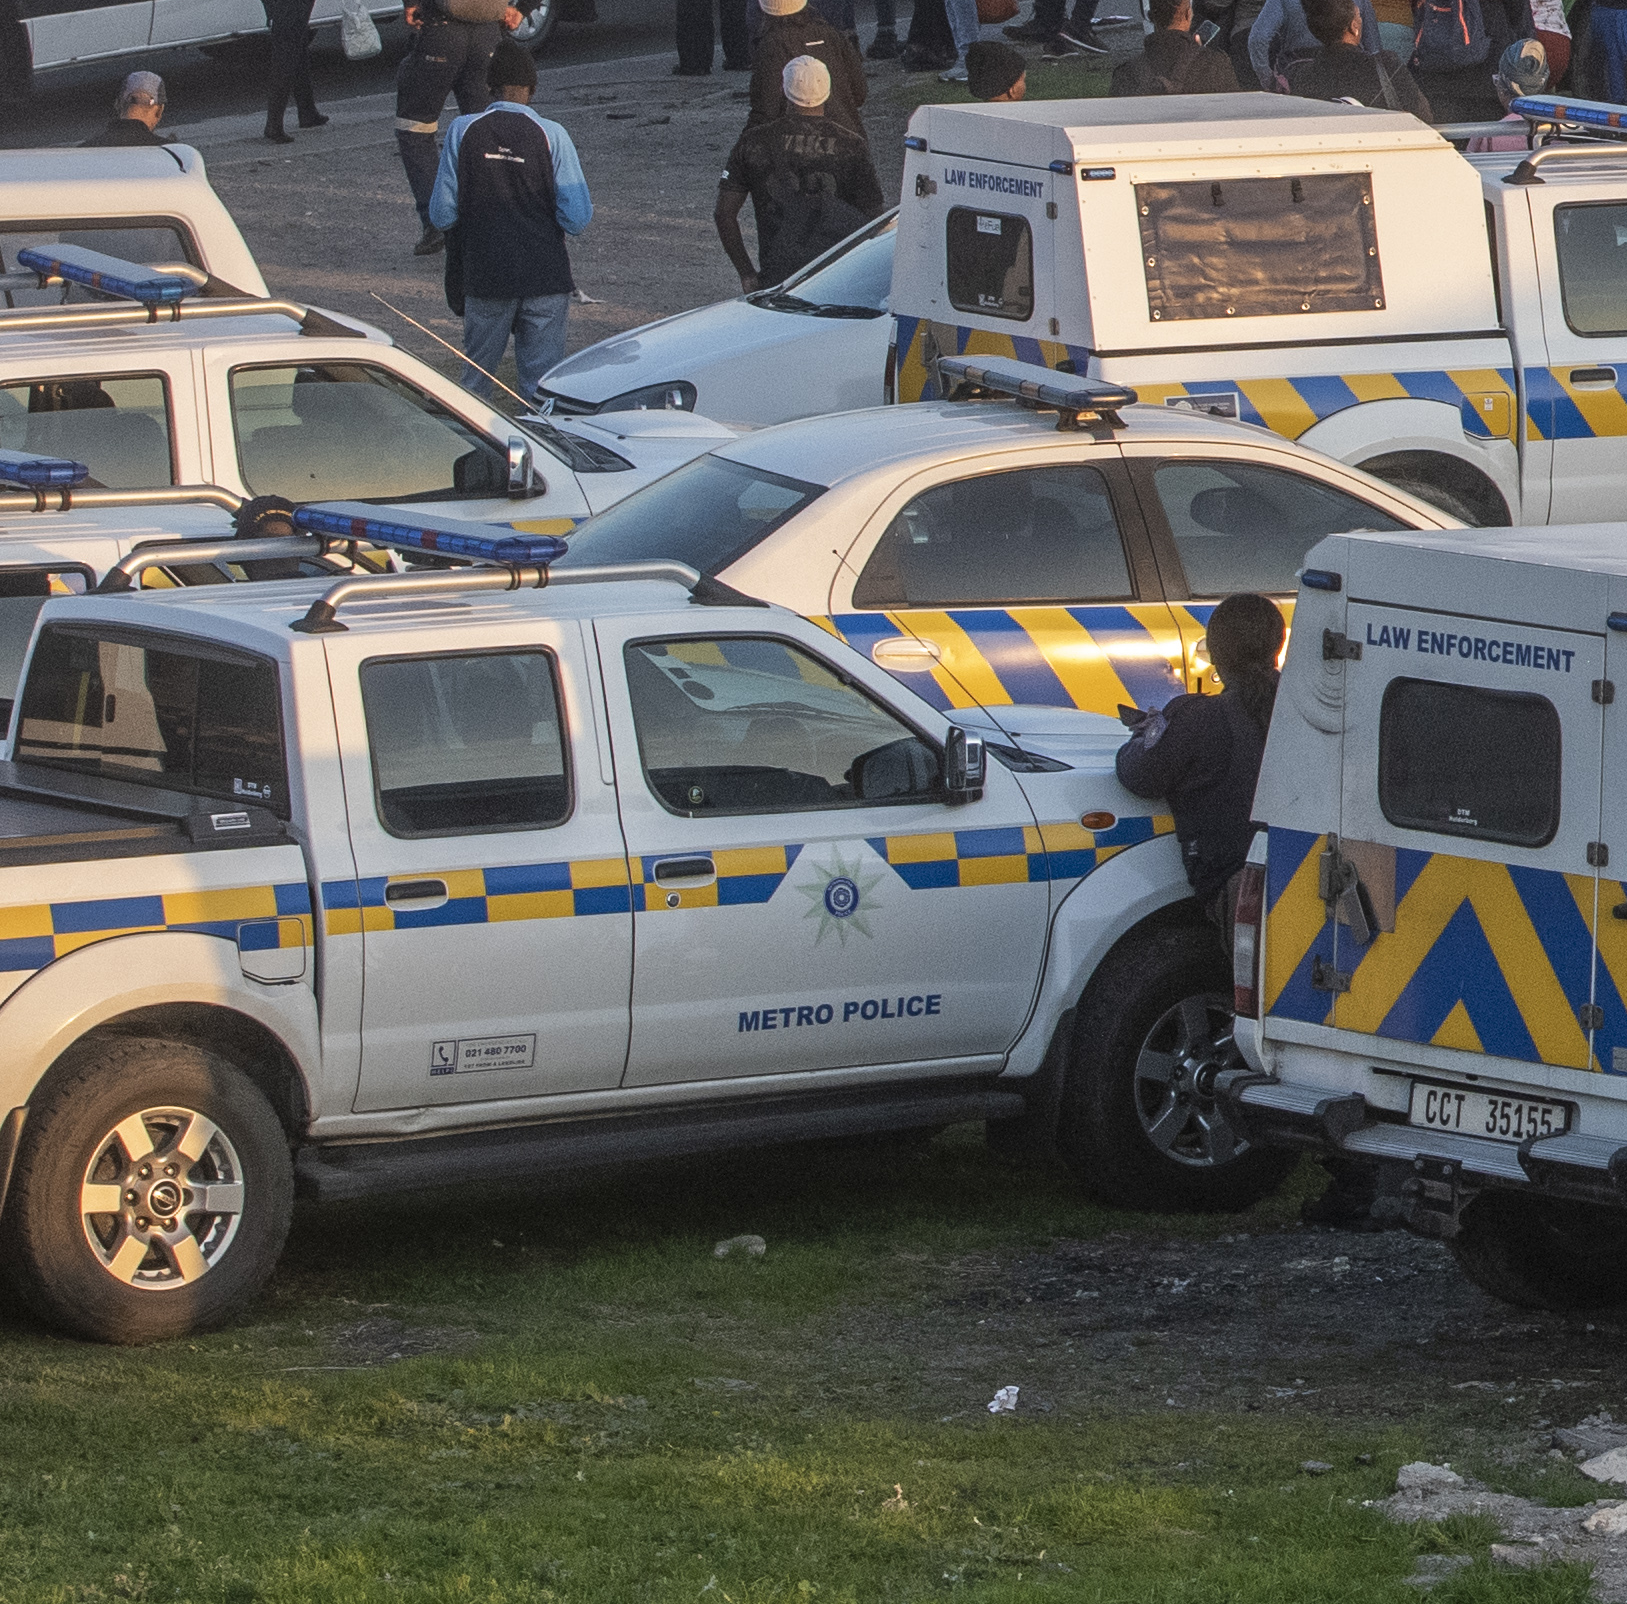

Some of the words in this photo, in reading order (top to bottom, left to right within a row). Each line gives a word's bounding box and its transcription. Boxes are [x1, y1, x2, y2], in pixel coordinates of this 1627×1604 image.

[944, 168, 966, 186] LAW
[968, 172, 1043, 199] ENFORCEMENT
[1365, 622, 1411, 651] LAW
[1416, 628, 1576, 674] ENFORCEMENT
[738, 1004, 833, 1033] METRO
[843, 994, 942, 1023] POLICE
[465, 1048, 482, 1058] 021
[485, 1046, 502, 1056] 480
[504, 1044, 527, 1054] 7700
[1425, 1091, 1466, 1127] CCT
[1485, 1098, 1553, 1140] 35155
